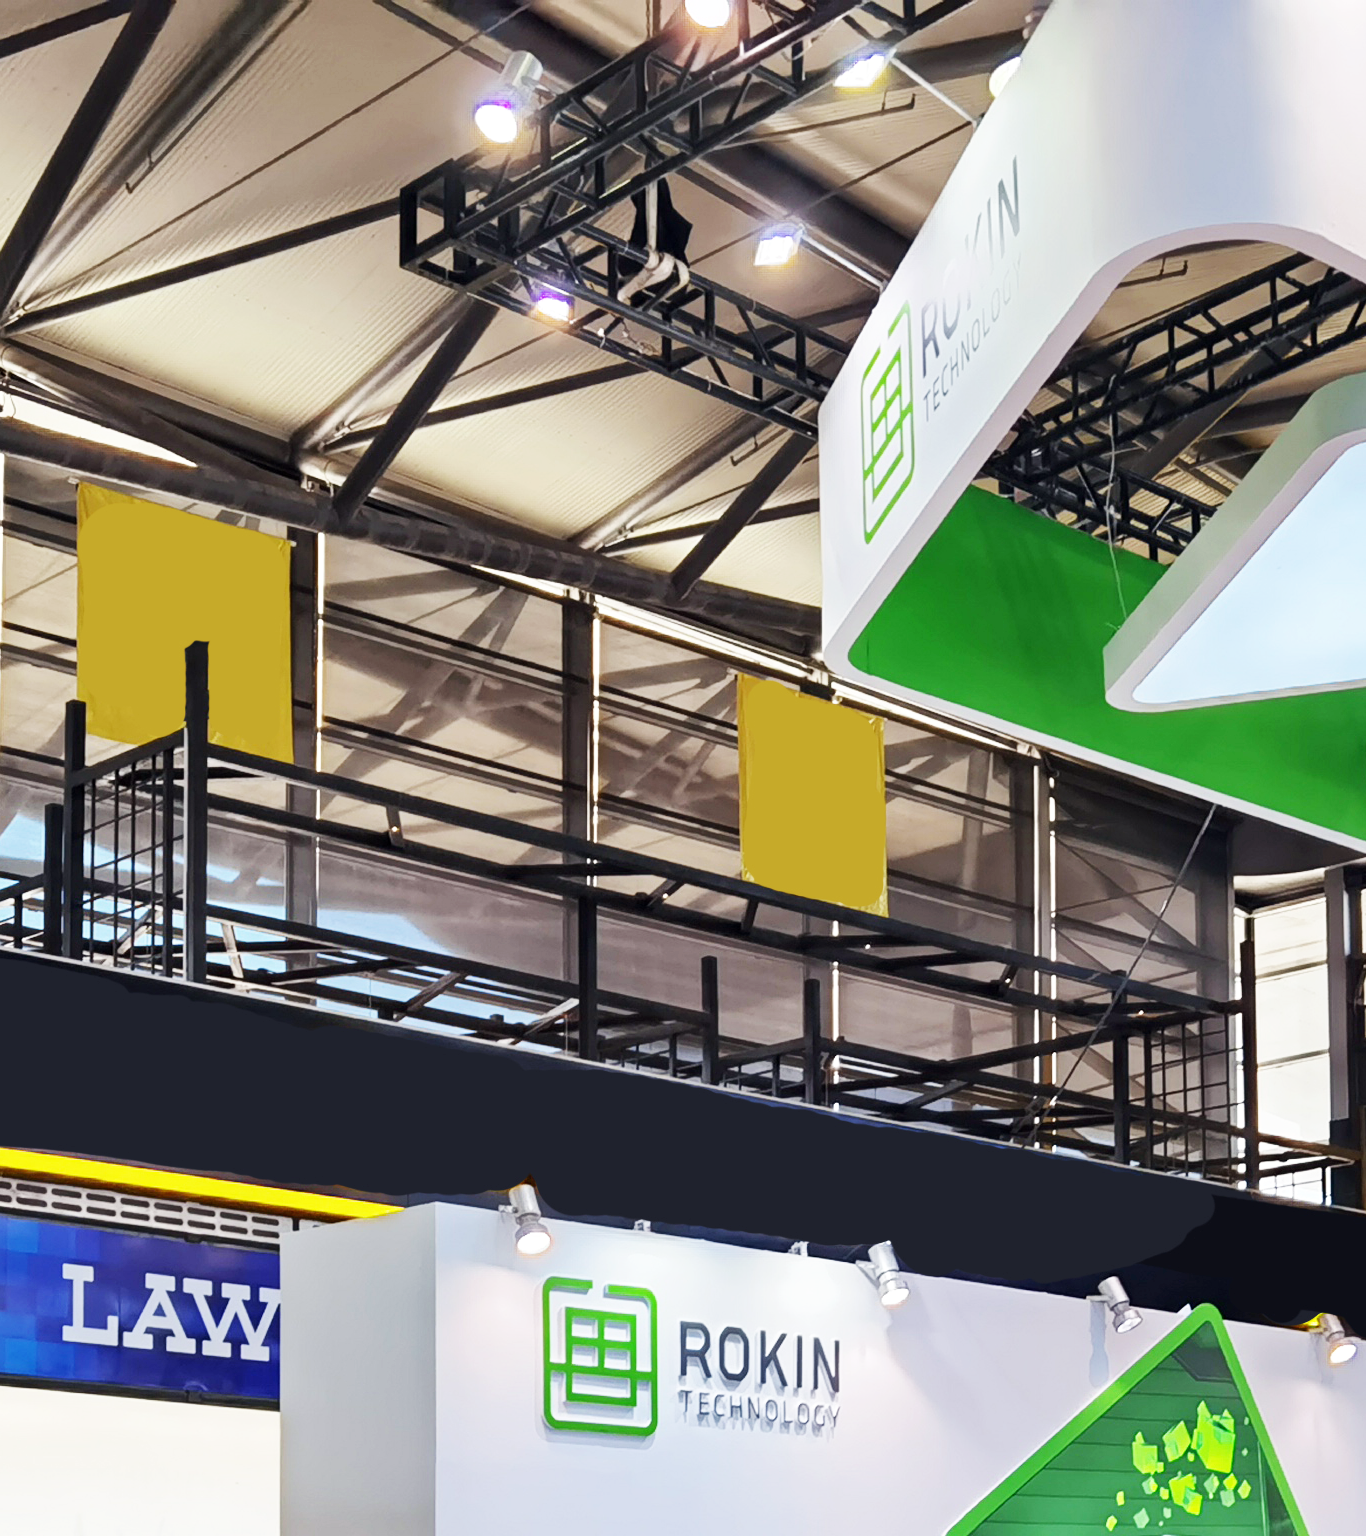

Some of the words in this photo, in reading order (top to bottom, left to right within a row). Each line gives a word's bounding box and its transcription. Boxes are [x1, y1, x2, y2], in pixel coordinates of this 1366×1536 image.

[921, 154, 1021, 379] ROKIN
[922, 252, 1022, 422] TECHNOLOGY
[62, 1262, 281, 1362] LAW
[680, 1320, 840, 1393] ROKIN
[678, 1389, 841, 1428] TECHNOLOGY
